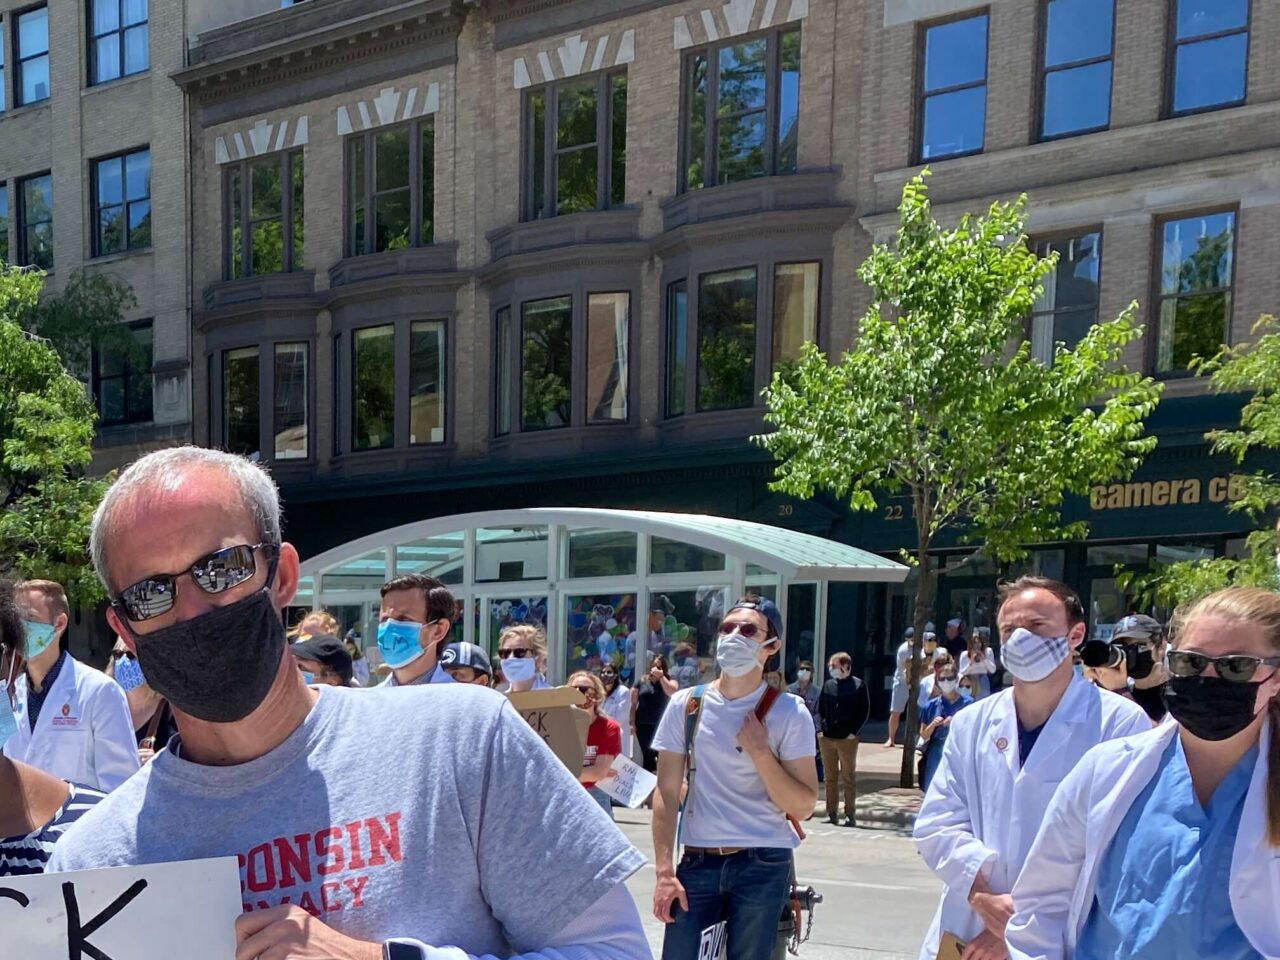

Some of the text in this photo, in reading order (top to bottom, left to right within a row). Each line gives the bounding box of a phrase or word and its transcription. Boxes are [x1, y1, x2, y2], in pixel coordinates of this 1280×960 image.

[1090, 478, 1200, 510] camera
[778, 505, 793, 516] 20
[884, 505, 903, 520] 22
